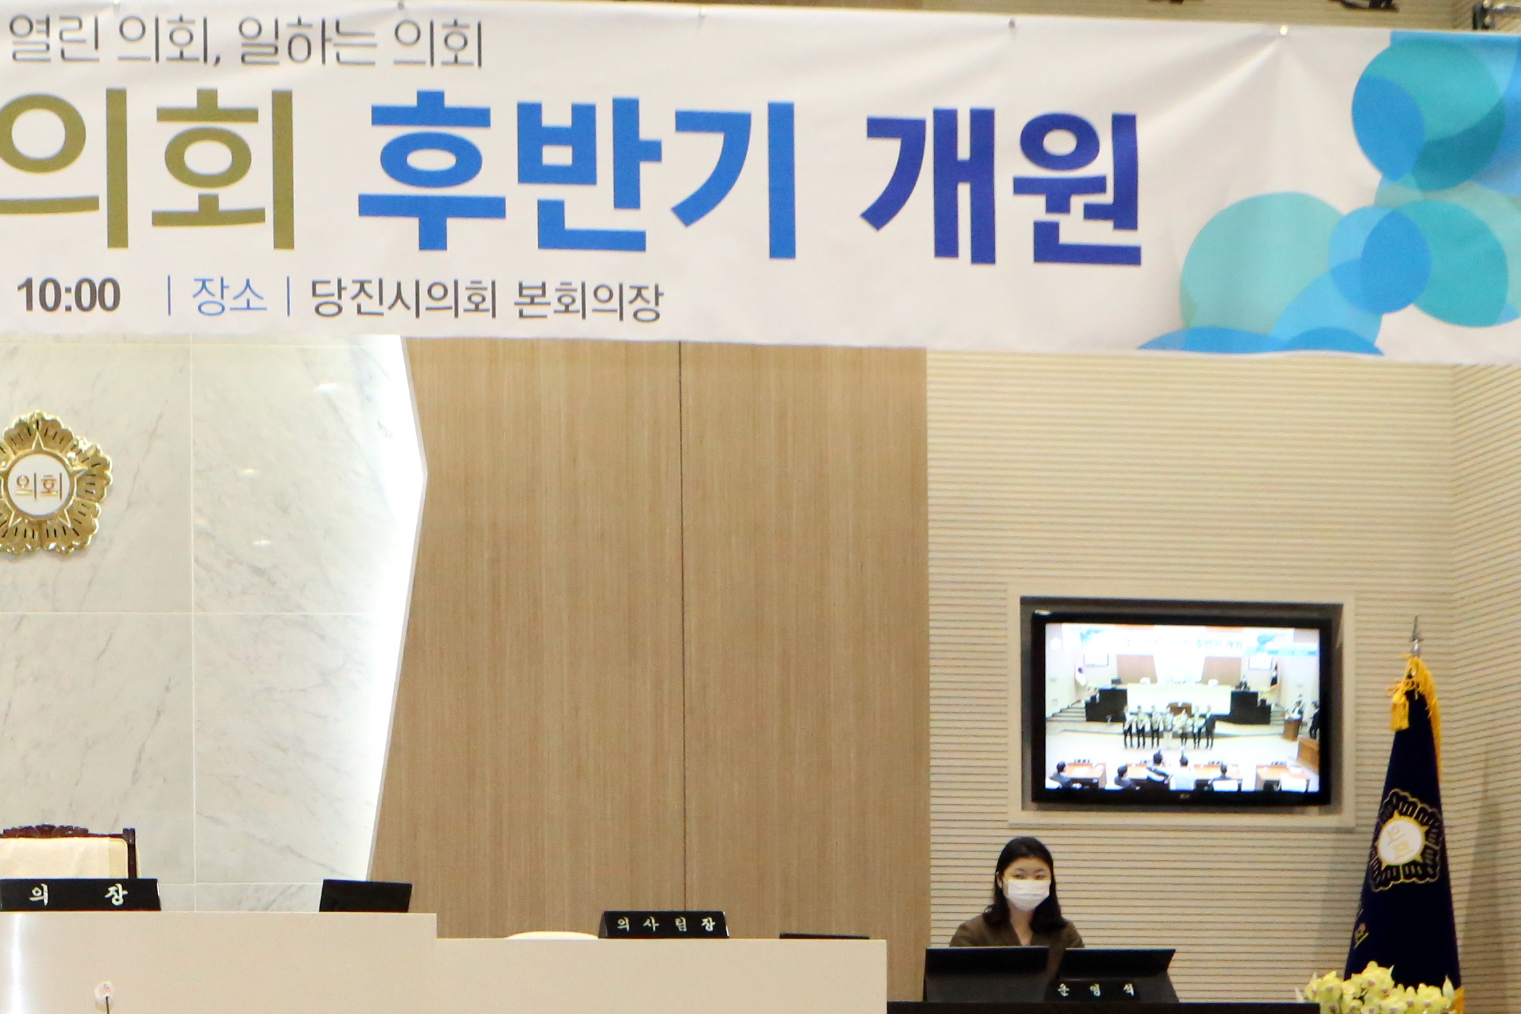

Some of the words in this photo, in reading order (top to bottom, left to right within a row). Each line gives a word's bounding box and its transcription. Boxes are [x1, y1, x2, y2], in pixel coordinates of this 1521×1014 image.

[9, 14, 100, 62] 열린
[117, 14, 221, 66] 의회,
[238, 16, 378, 66] 일하는
[393, 18, 482, 68] 의회
[357, 90, 797, 261] 후반기
[859, 107, 1142, 267] 개원
[17, 276, 121, 313] 10:00
[192, 275, 268, 316] 장소
[311, 278, 497, 319] 당진시의회
[513, 281, 665, 324] 본회의장
[14, 471, 64, 502] 의회
